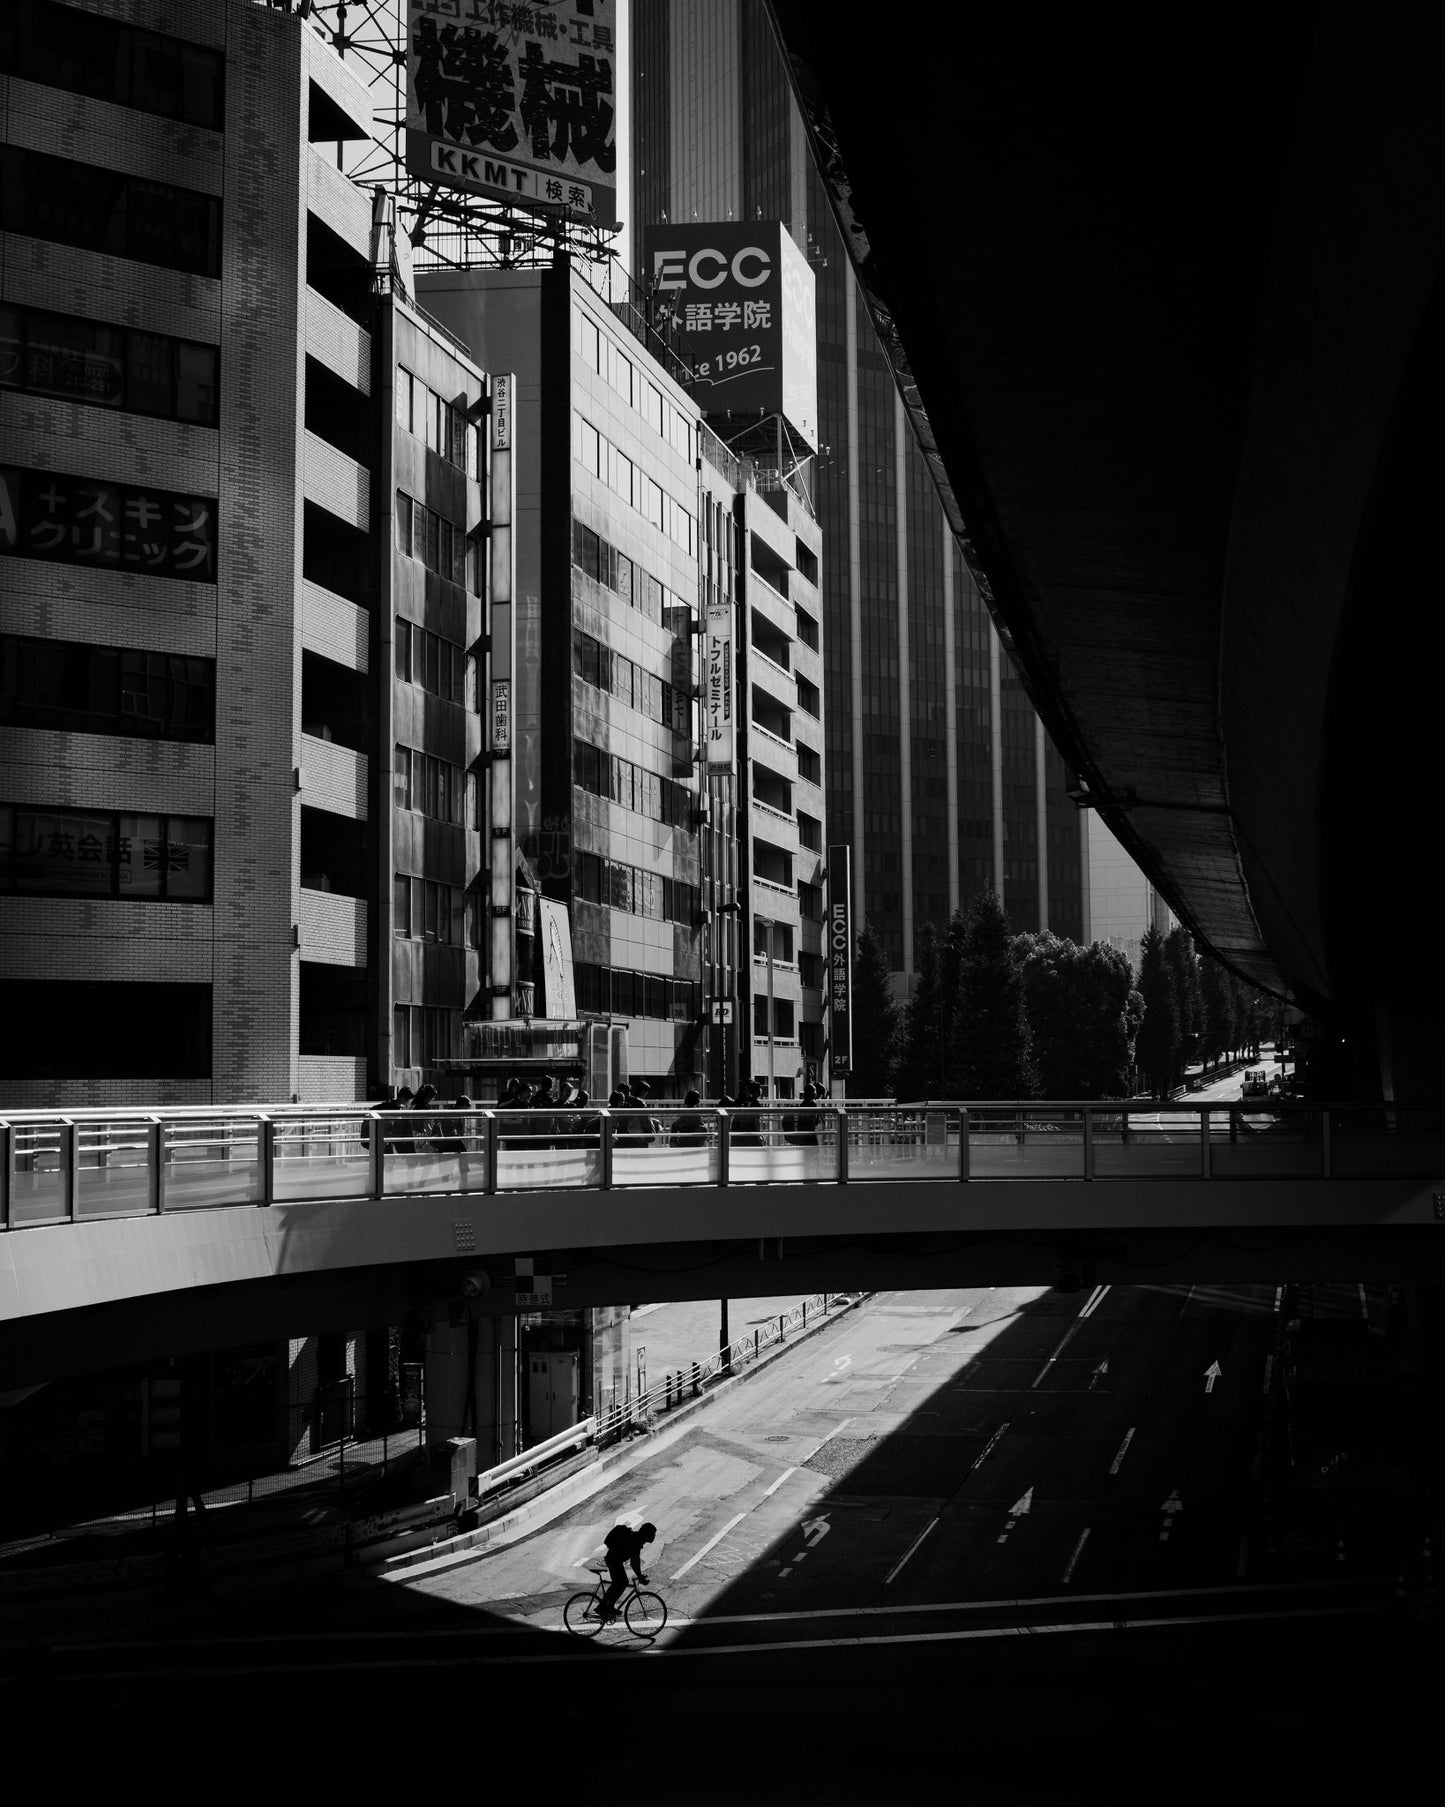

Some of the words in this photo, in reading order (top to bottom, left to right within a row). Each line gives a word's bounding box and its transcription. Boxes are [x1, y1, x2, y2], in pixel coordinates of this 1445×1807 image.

[413, 16, 616, 173] 機械
[438, 147, 527, 191] KKMT
[546, 179, 585, 208] 検索
[654, 246, 771, 290] ECC
[715, 344, 762, 373] 1962
[496, 377, 506, 448] 渋谷二丁目ビル
[31, 520, 208, 570] クリニック
[495, 684, 508, 741] 武田歯科
[709, 636, 722, 741] トフルゼミナール
[834, 1056, 848, 1065] 2F
